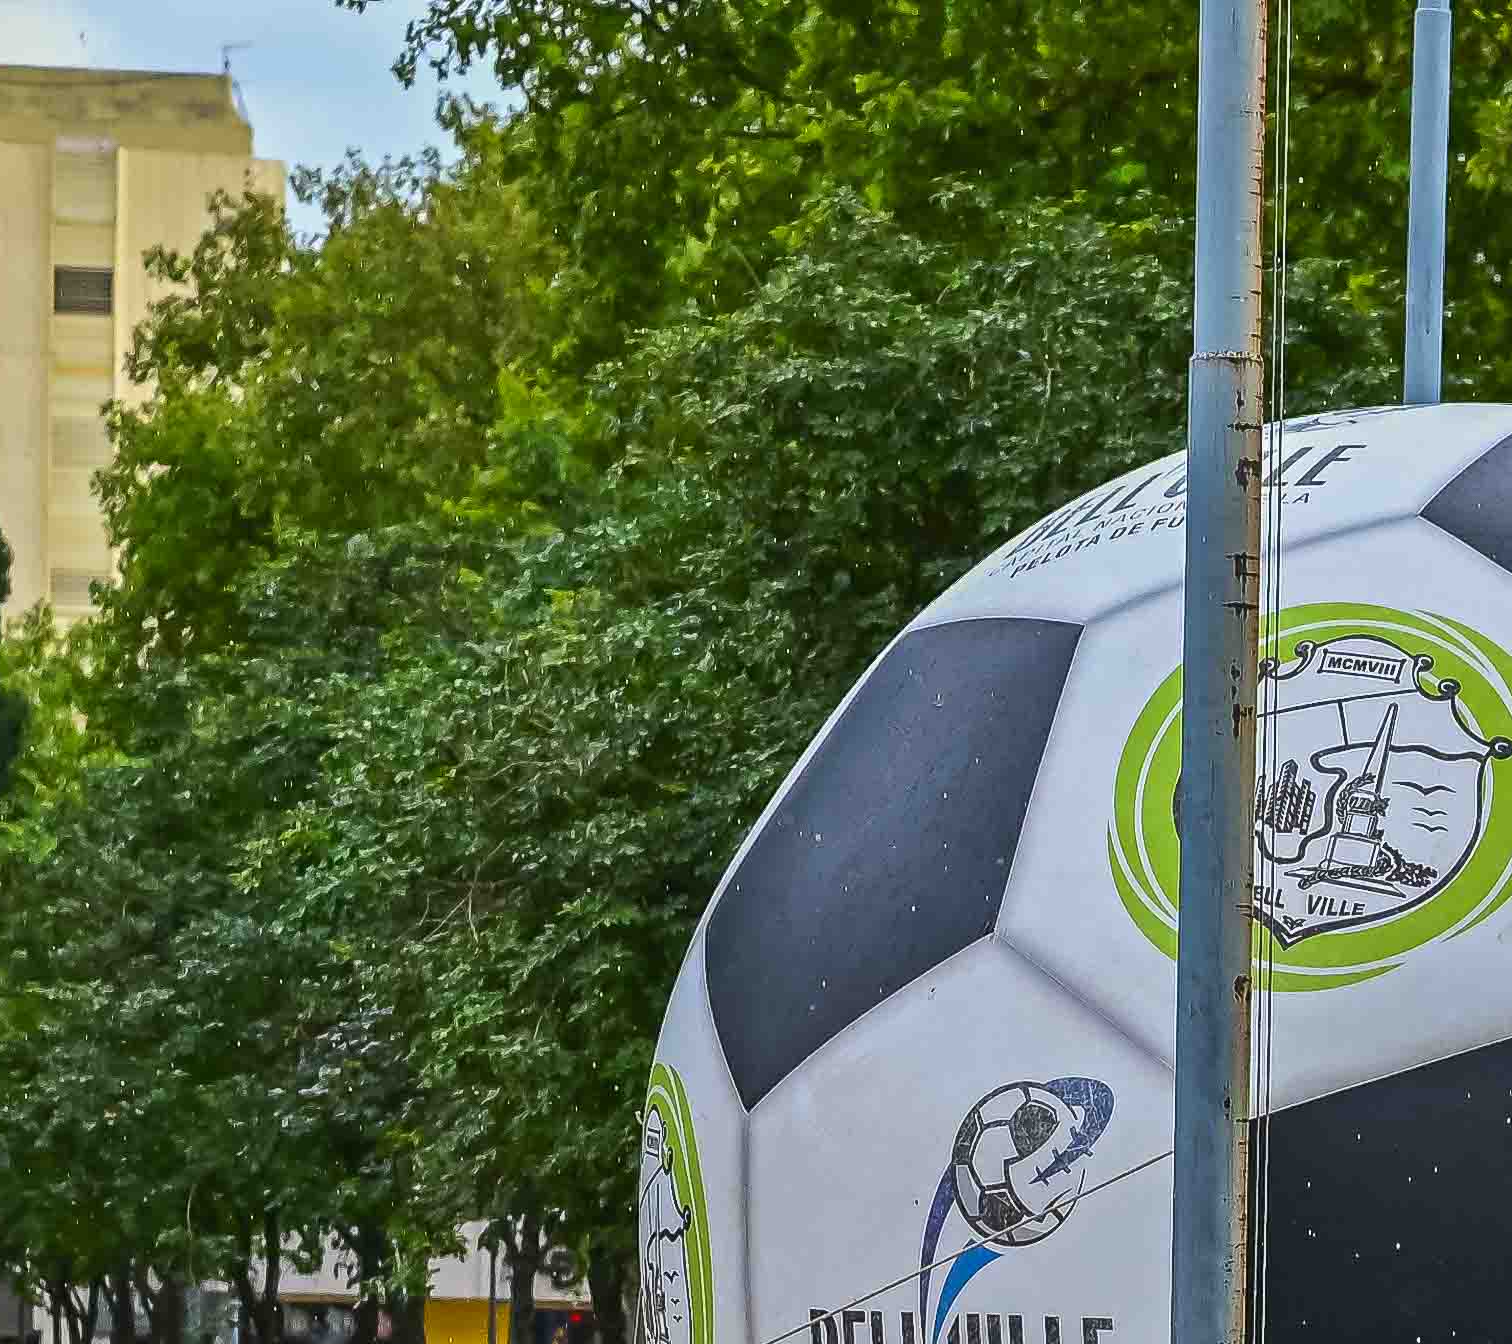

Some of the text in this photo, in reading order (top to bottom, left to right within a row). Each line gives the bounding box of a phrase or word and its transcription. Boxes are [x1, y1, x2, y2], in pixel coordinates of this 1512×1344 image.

[1327, 656, 1397, 678] MCMVIII
[1255, 885, 1366, 917] ELL VILLE
